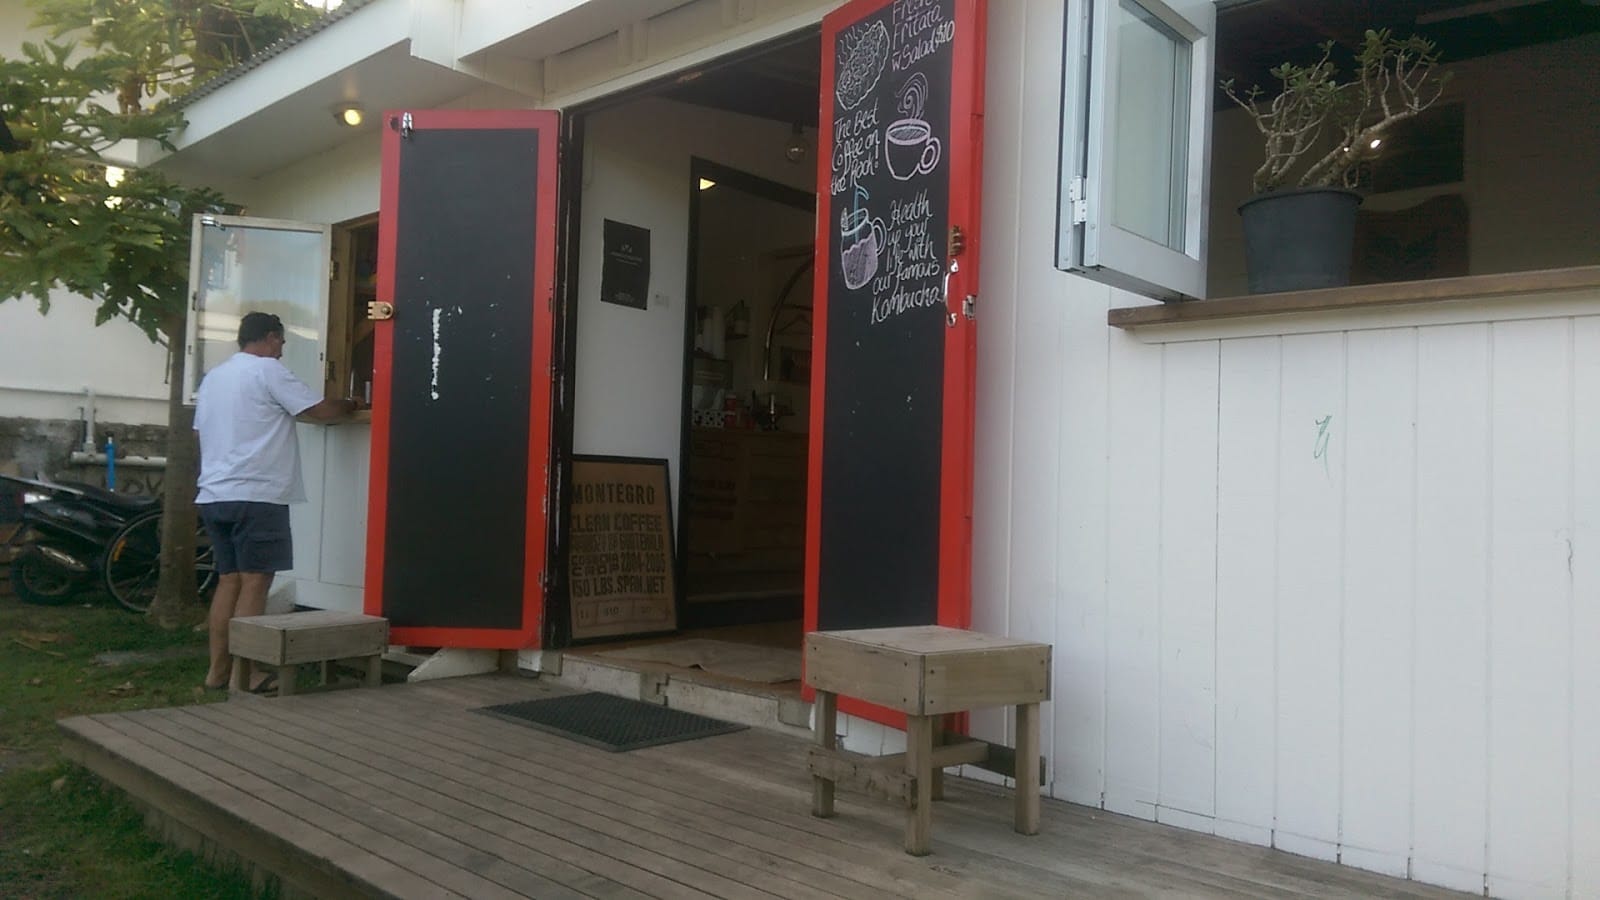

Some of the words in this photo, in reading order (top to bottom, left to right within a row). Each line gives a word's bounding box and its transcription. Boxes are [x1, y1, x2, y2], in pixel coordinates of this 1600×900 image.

[901, 28, 935, 70] Salad
[834, 117, 851, 144] The
[832, 137, 864, 179] Coffee
[865, 129, 880, 150] on
[831, 175, 847, 196] the
[571, 482, 656, 505] MONTEGRO
[613, 512, 663, 533] COFFEE
